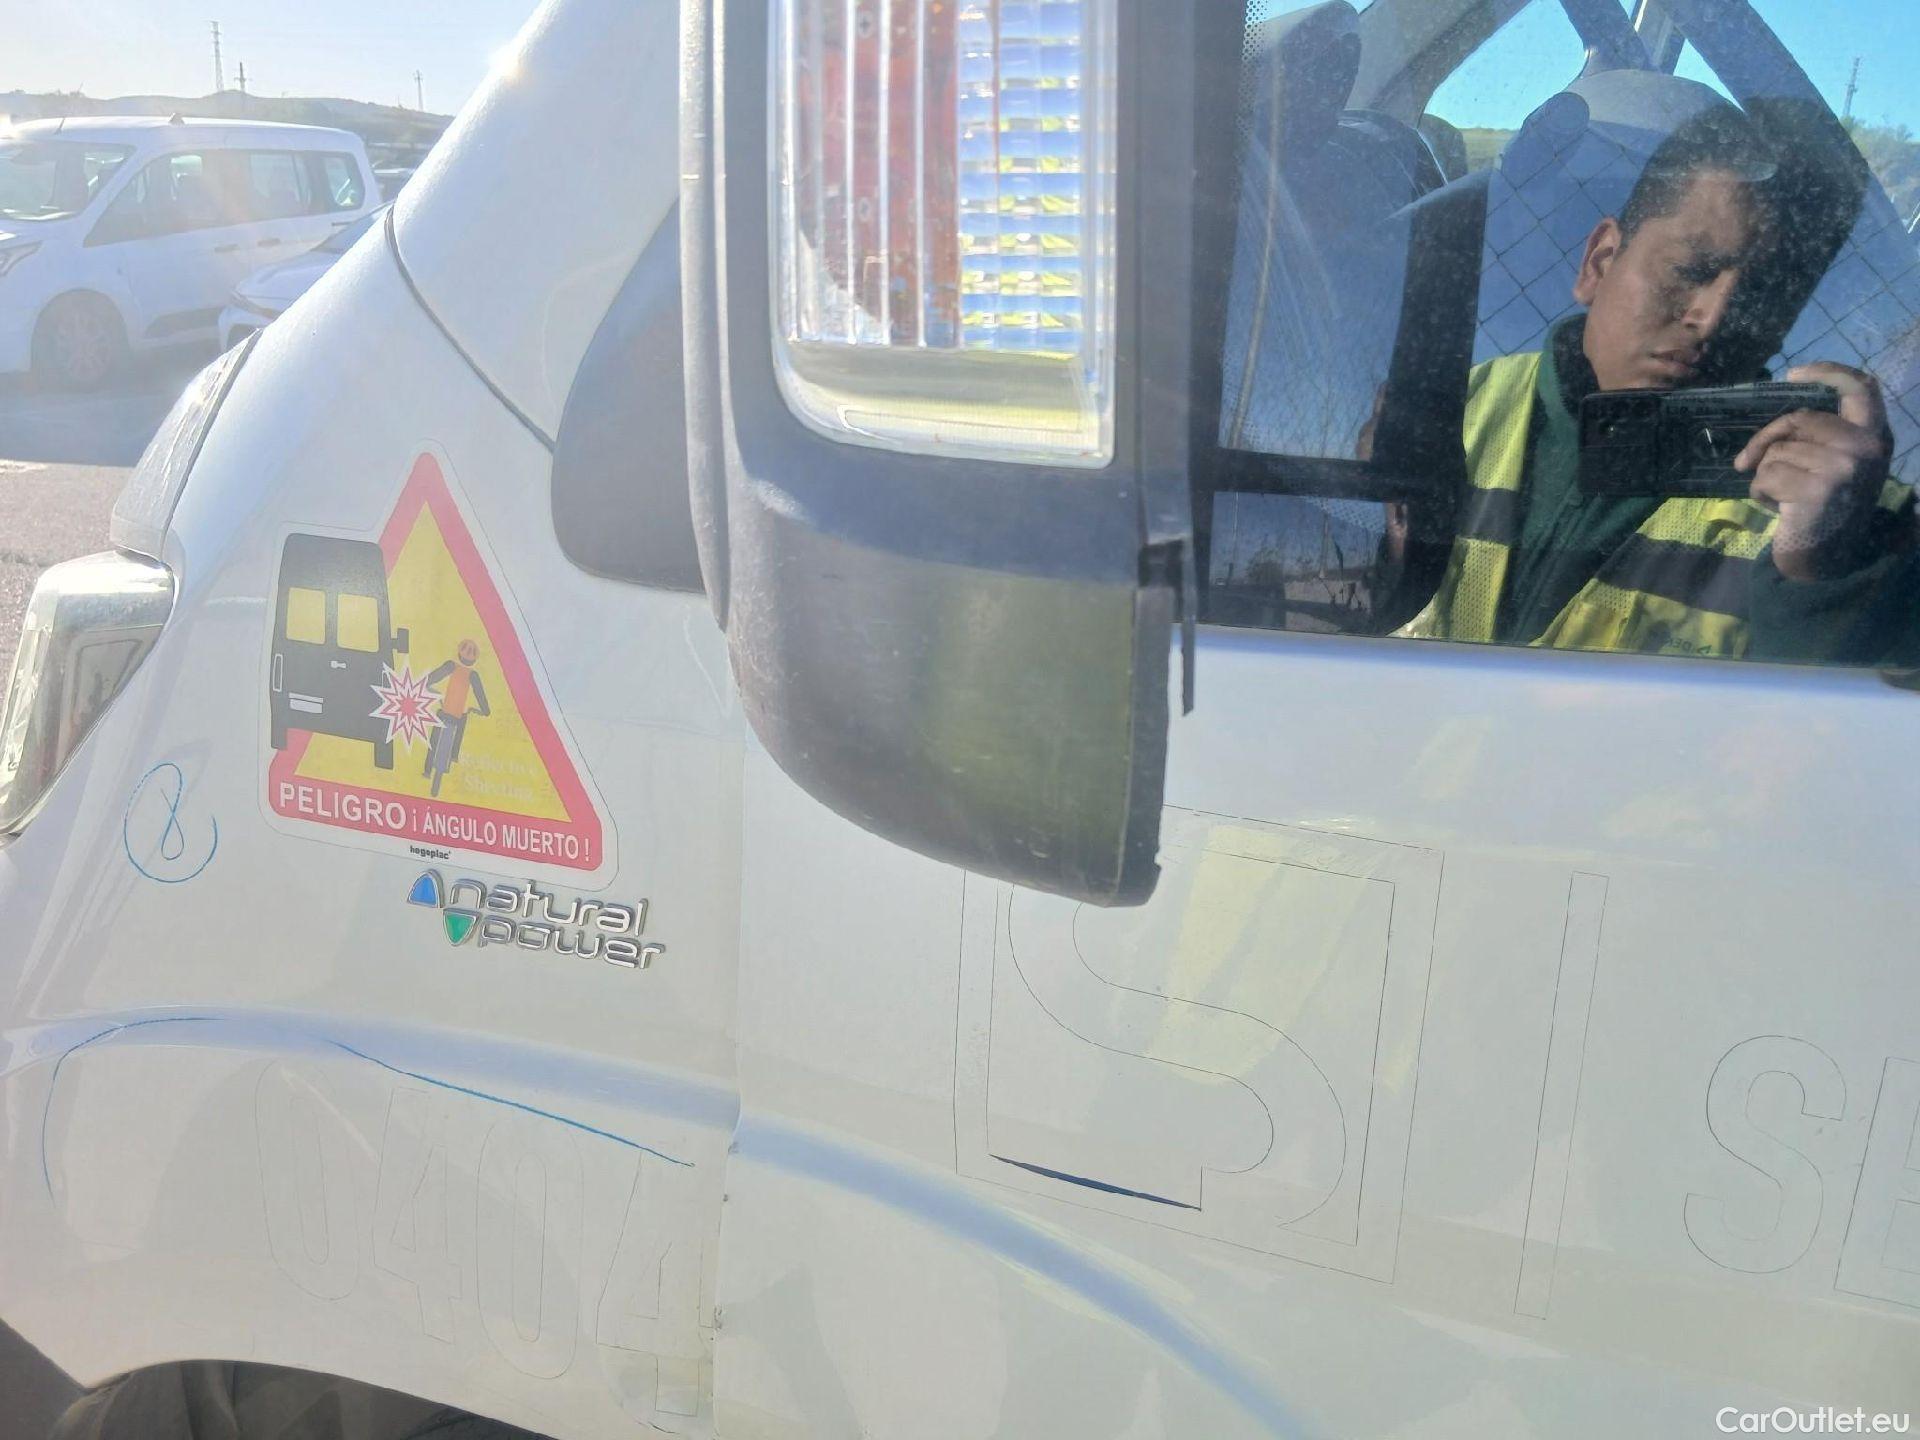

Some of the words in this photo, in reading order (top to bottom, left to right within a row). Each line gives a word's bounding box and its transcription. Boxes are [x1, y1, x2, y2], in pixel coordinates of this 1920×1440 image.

[279, 781, 407, 830] PELIGRO
[422, 806, 497, 846] ÁNGULO
[502, 824, 579, 860] MUERTO
[450, 878, 649, 937] natural
[478, 914, 666, 970] power
